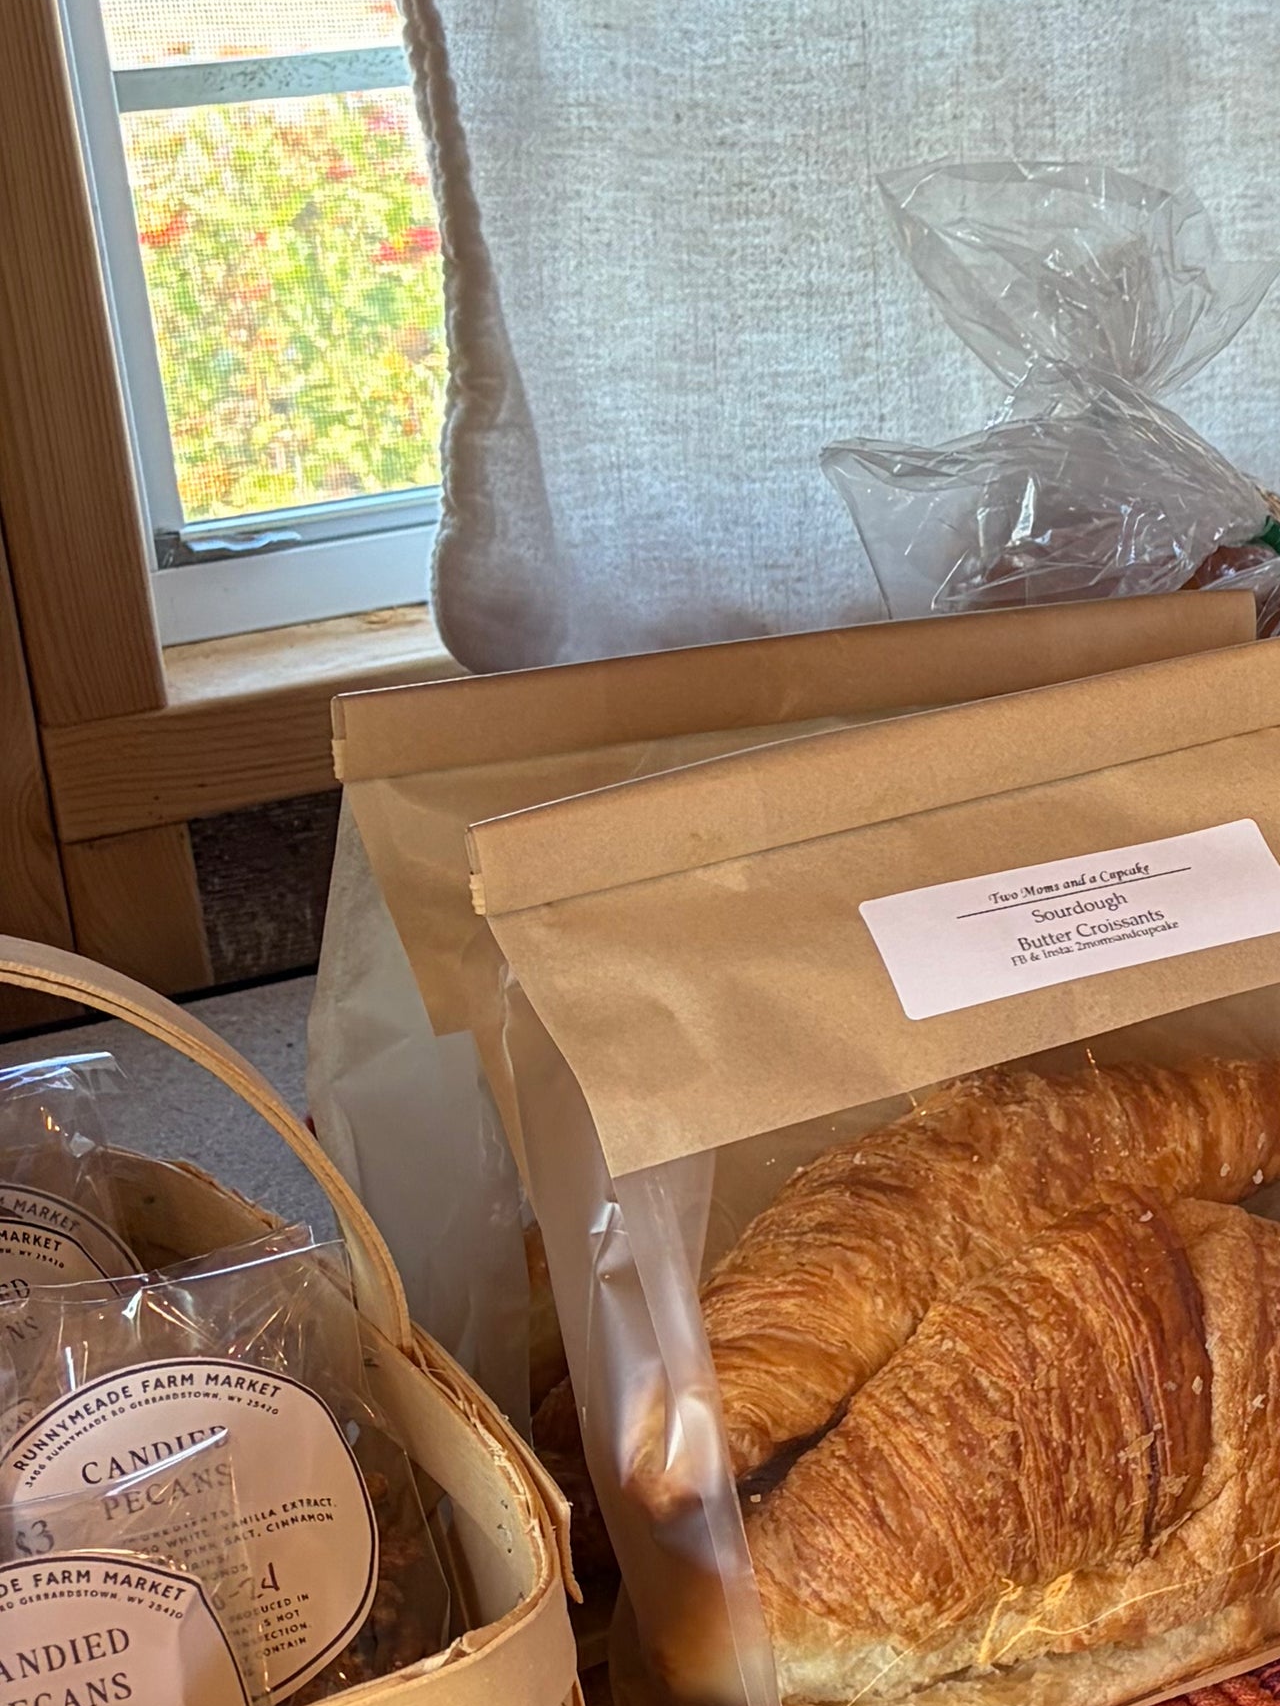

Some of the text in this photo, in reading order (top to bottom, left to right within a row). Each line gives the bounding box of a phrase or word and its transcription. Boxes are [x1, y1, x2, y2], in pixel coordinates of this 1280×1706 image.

[988, 862, 1151, 905] Two Moms and a Cupcake
[1031, 892, 1129, 924] Sourdough
[1017, 908, 1166, 953] Butter Croissants
[13, 1198, 81, 1232] MARKET
[13, 1372, 283, 1473] RUNNYMEADE FARM MARKET
[80, 1424, 231, 1486] CANDIED
[32, 1569, 187, 1603] FARM MARKET
[0, 1627, 131, 1685] ANDIED
